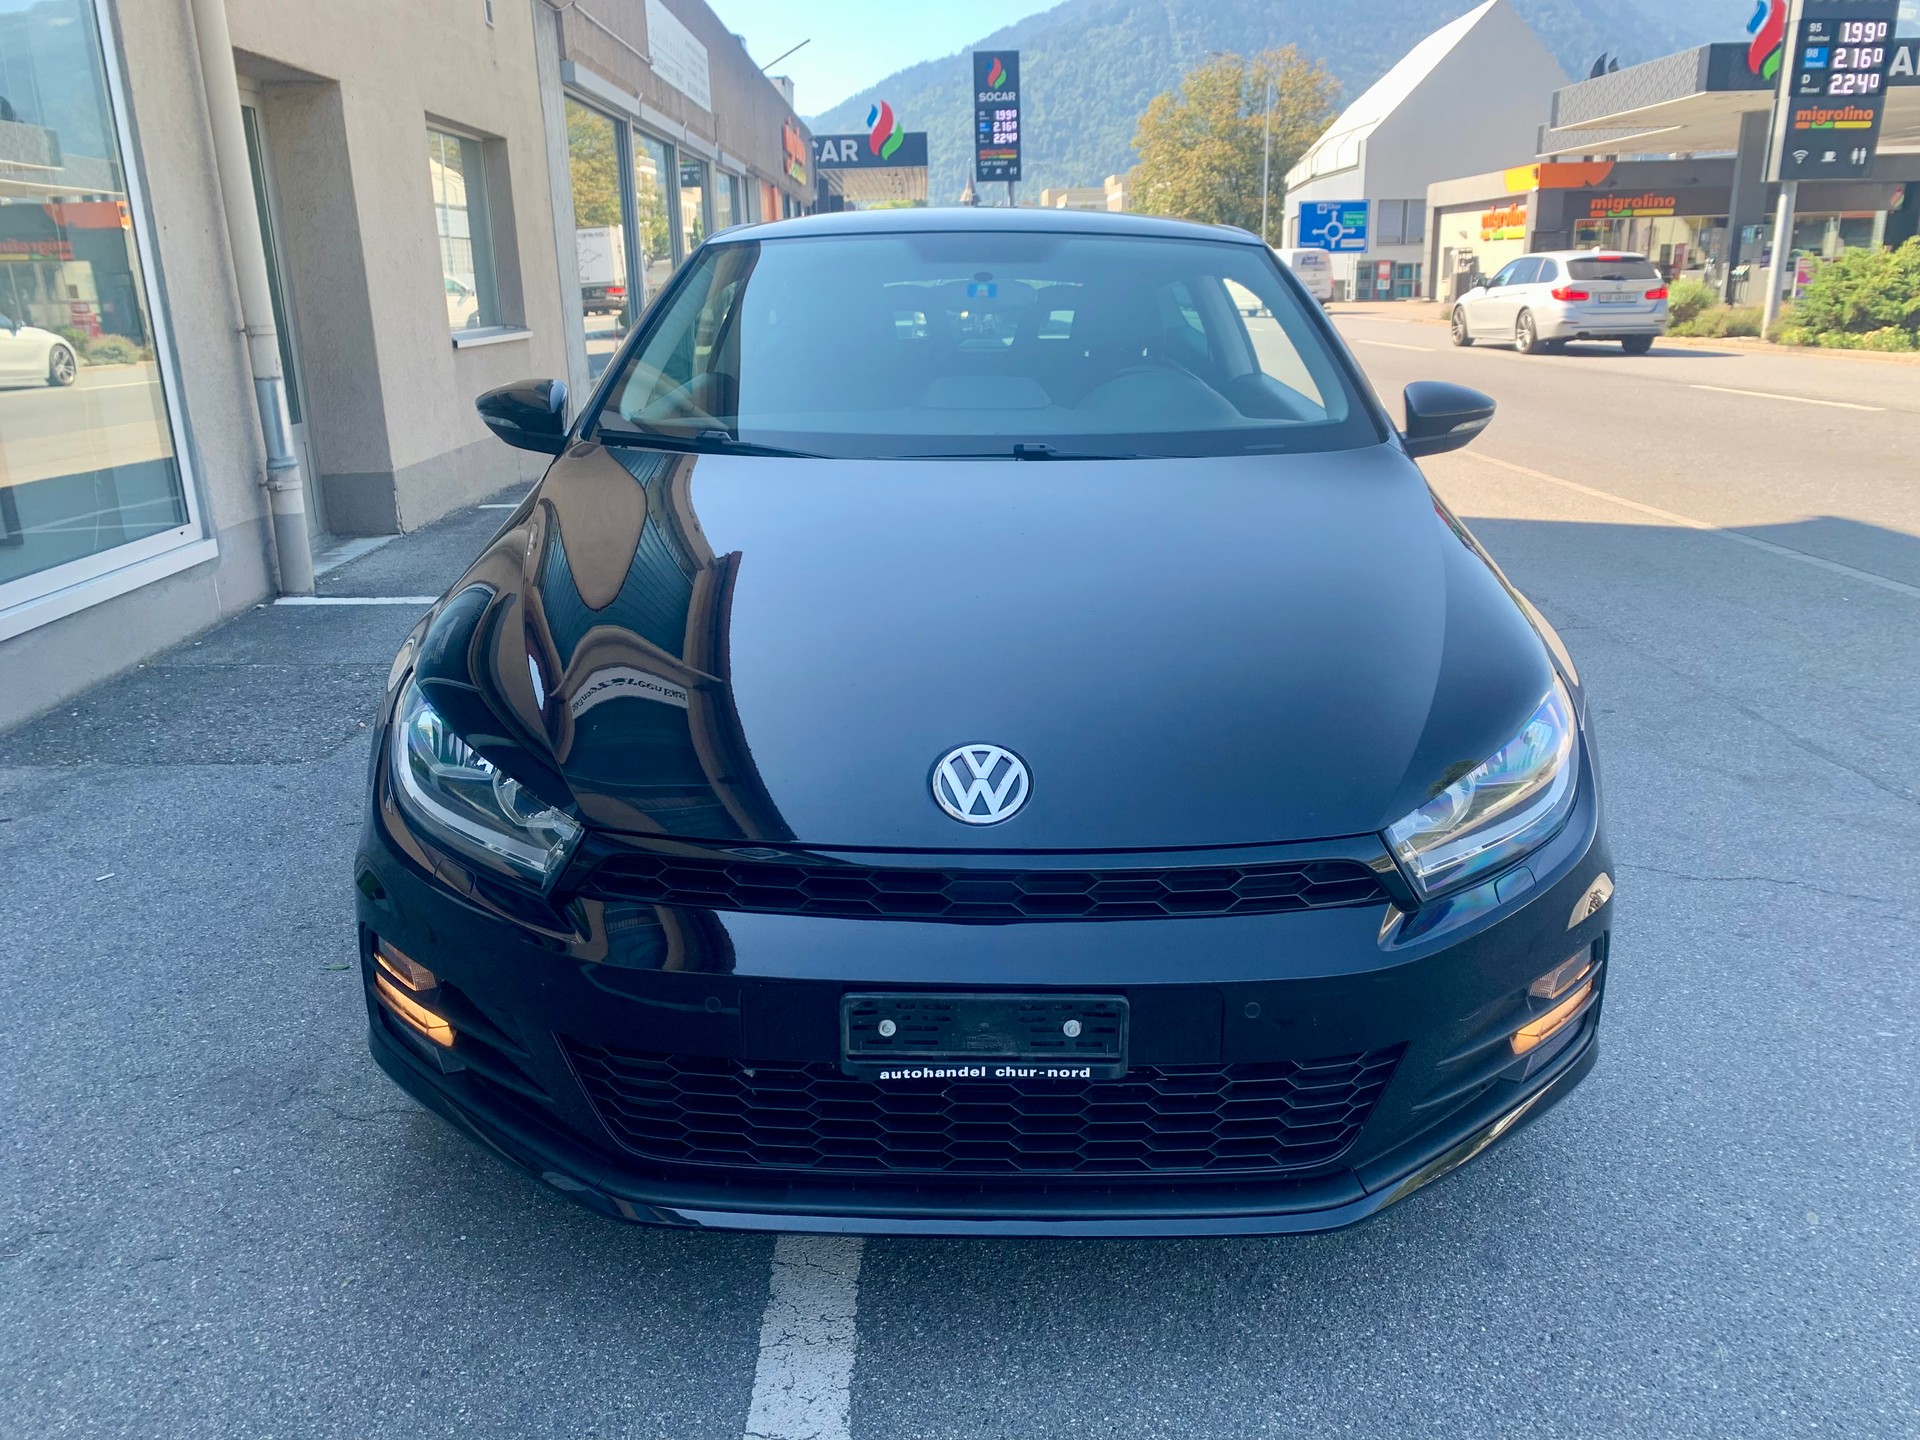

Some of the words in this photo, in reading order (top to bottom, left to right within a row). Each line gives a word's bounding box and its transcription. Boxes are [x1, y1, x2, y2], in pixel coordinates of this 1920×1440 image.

[1810, 22, 1823, 33] 95
[1889, 46, 1920, 76] A
[1801, 75, 1811, 84] D
[979, 91, 1016, 102] SOCAR
[1795, 105, 1874, 124] migrolino
[812, 139, 859, 162] AR
[1590, 192, 1676, 212] migrolino
[879, 1066, 986, 1080] autohandel
[995, 1066, 1091, 1079] chur-nord
